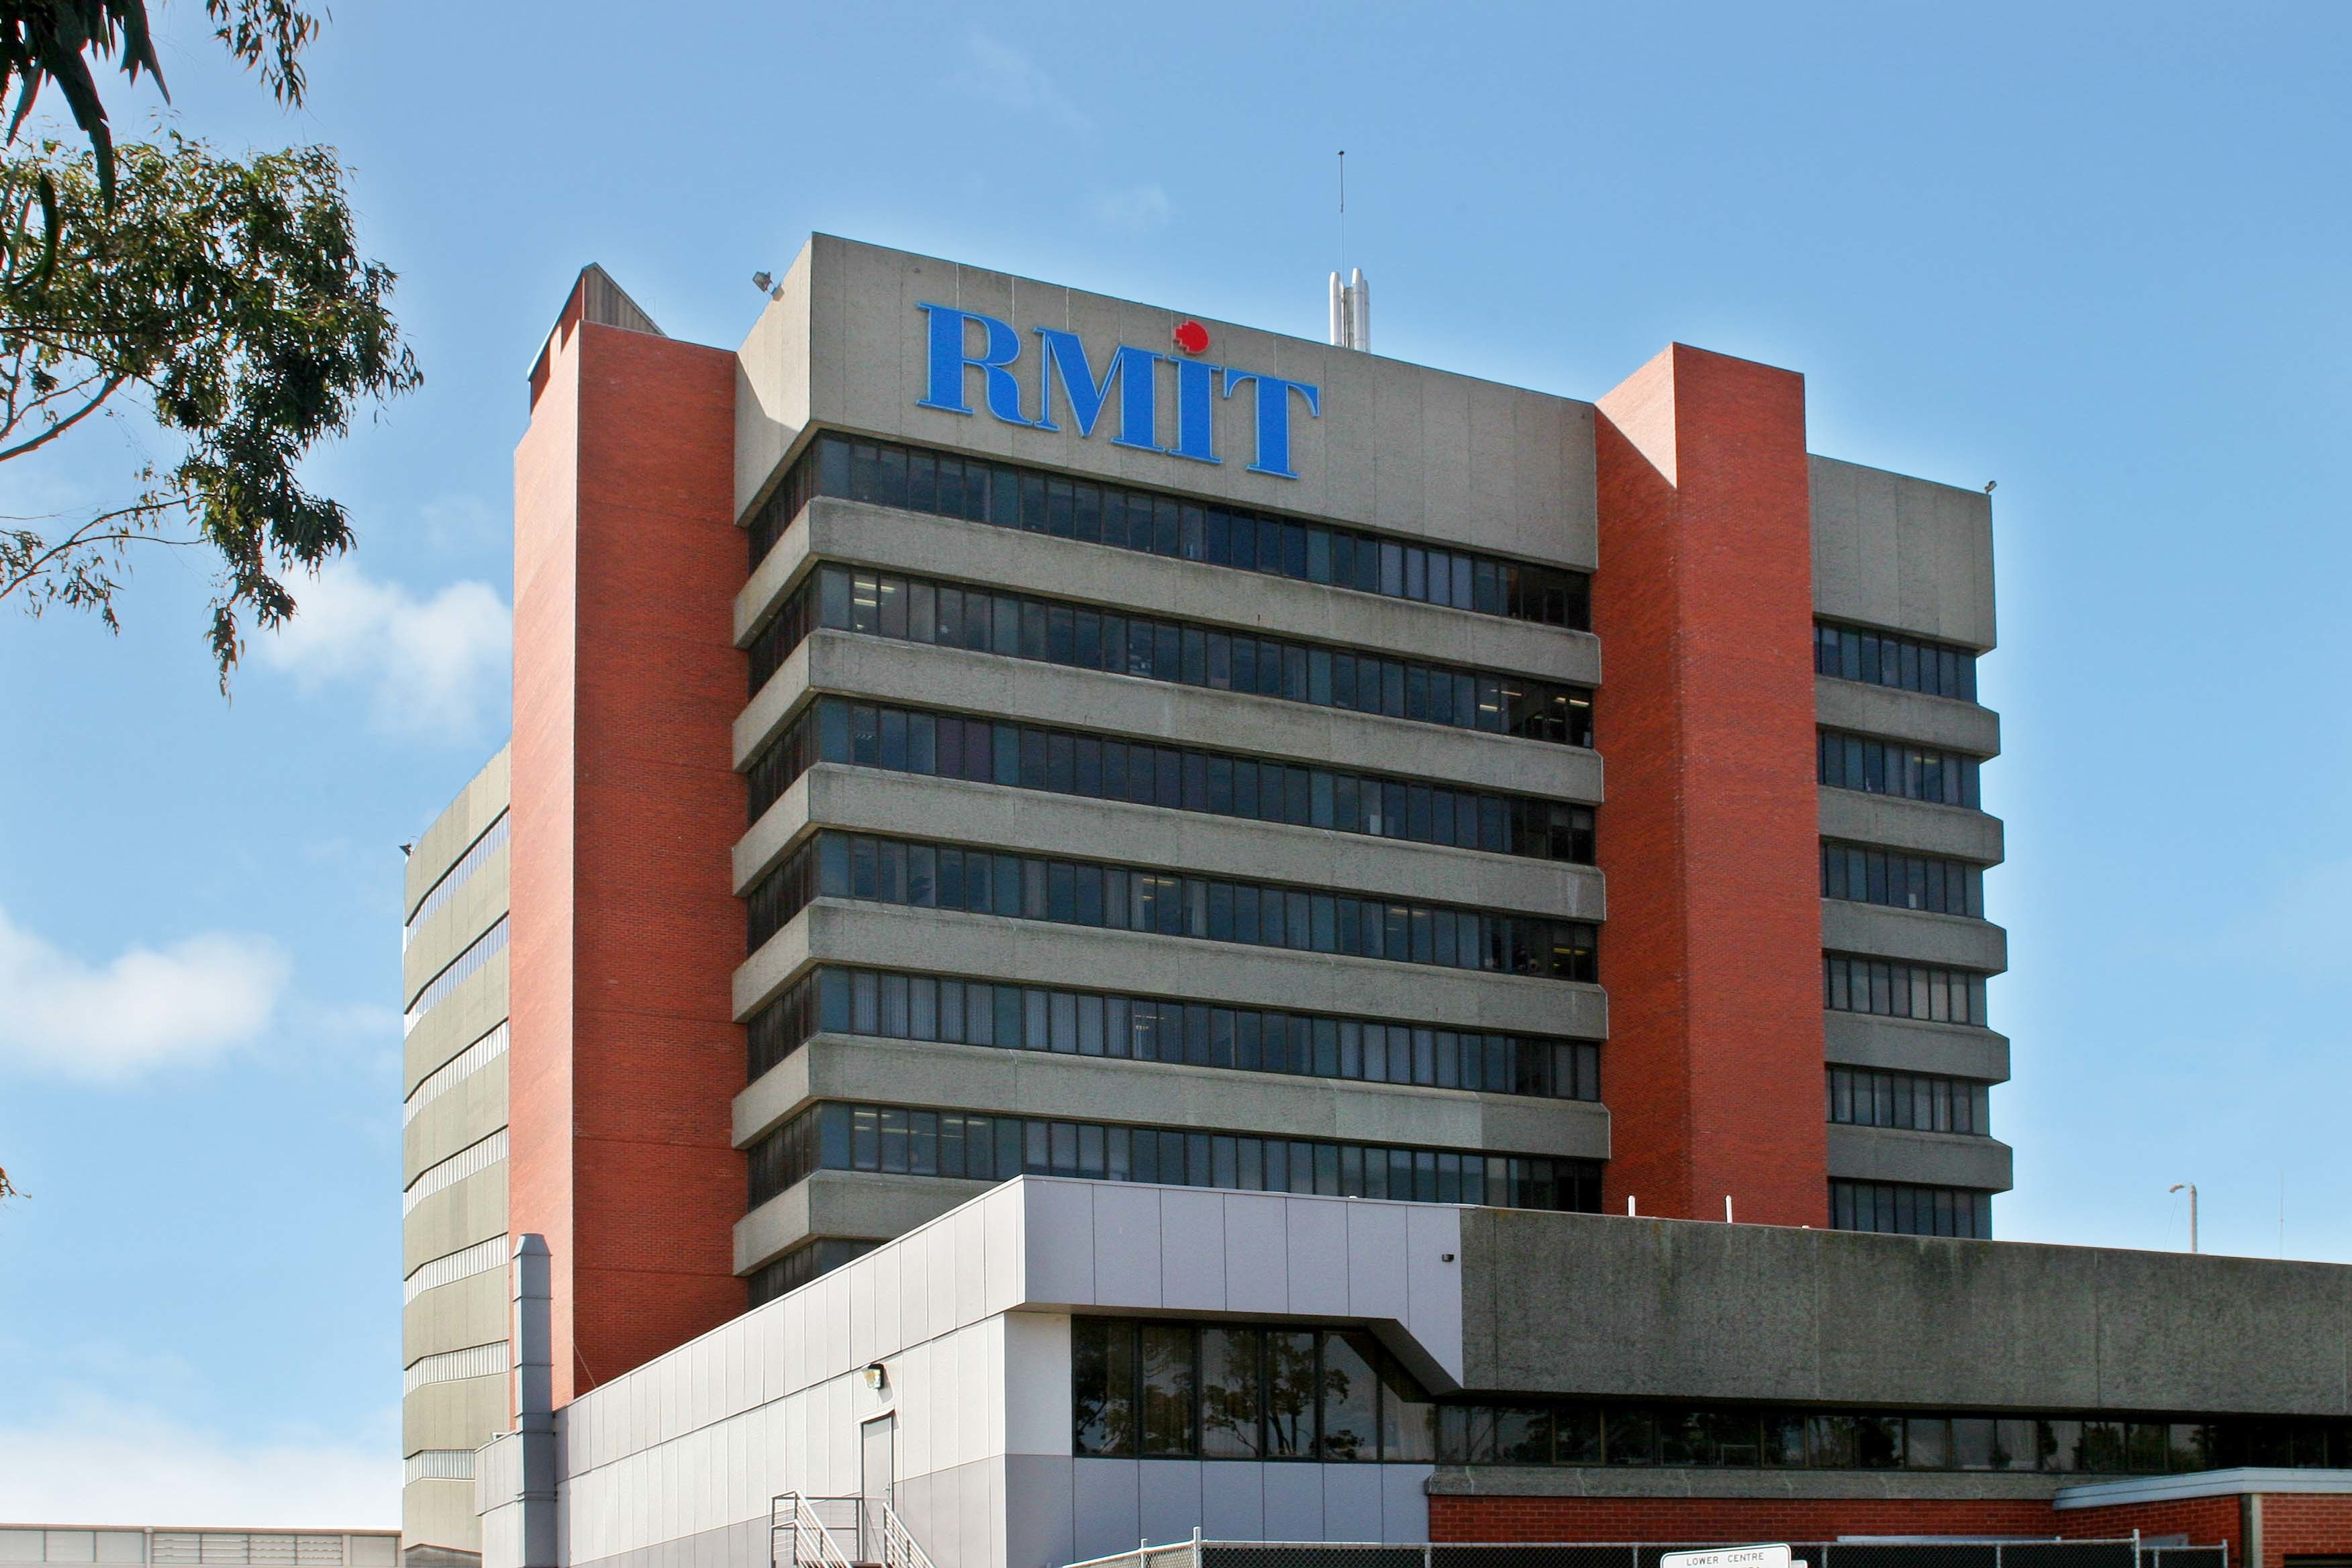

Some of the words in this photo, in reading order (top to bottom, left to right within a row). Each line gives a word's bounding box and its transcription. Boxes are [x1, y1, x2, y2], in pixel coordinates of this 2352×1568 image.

[916, 302, 1320, 479] RMIT
[1687, 1556, 1719, 1566] LOWER
[1727, 1552, 1765, 1563] CENTRE
